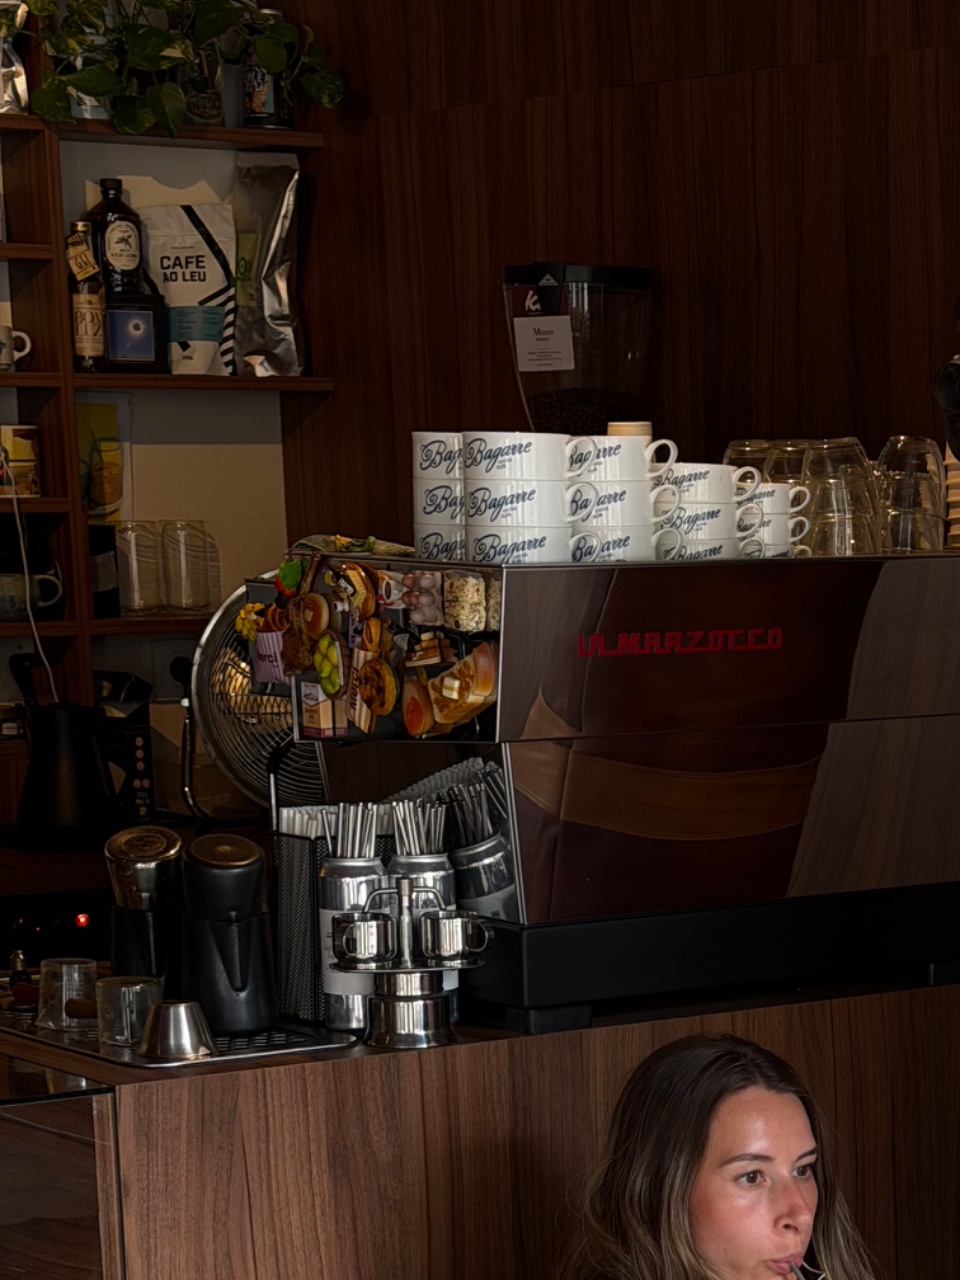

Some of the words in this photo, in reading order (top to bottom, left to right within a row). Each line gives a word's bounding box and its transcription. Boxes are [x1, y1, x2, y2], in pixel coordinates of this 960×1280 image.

[160, 255, 206, 270] CAFE
[163, 271, 178, 283] AO
[182, 271, 206, 282] LEU
[464, 438, 532, 473] Bagarre
[467, 487, 536, 522] Bagarre
[473, 533, 547, 562] Bagarre
[578, 634, 605, 657] LA
[618, 627, 783, 656] MARZOCCO
[257, 651, 278, 664] erci
